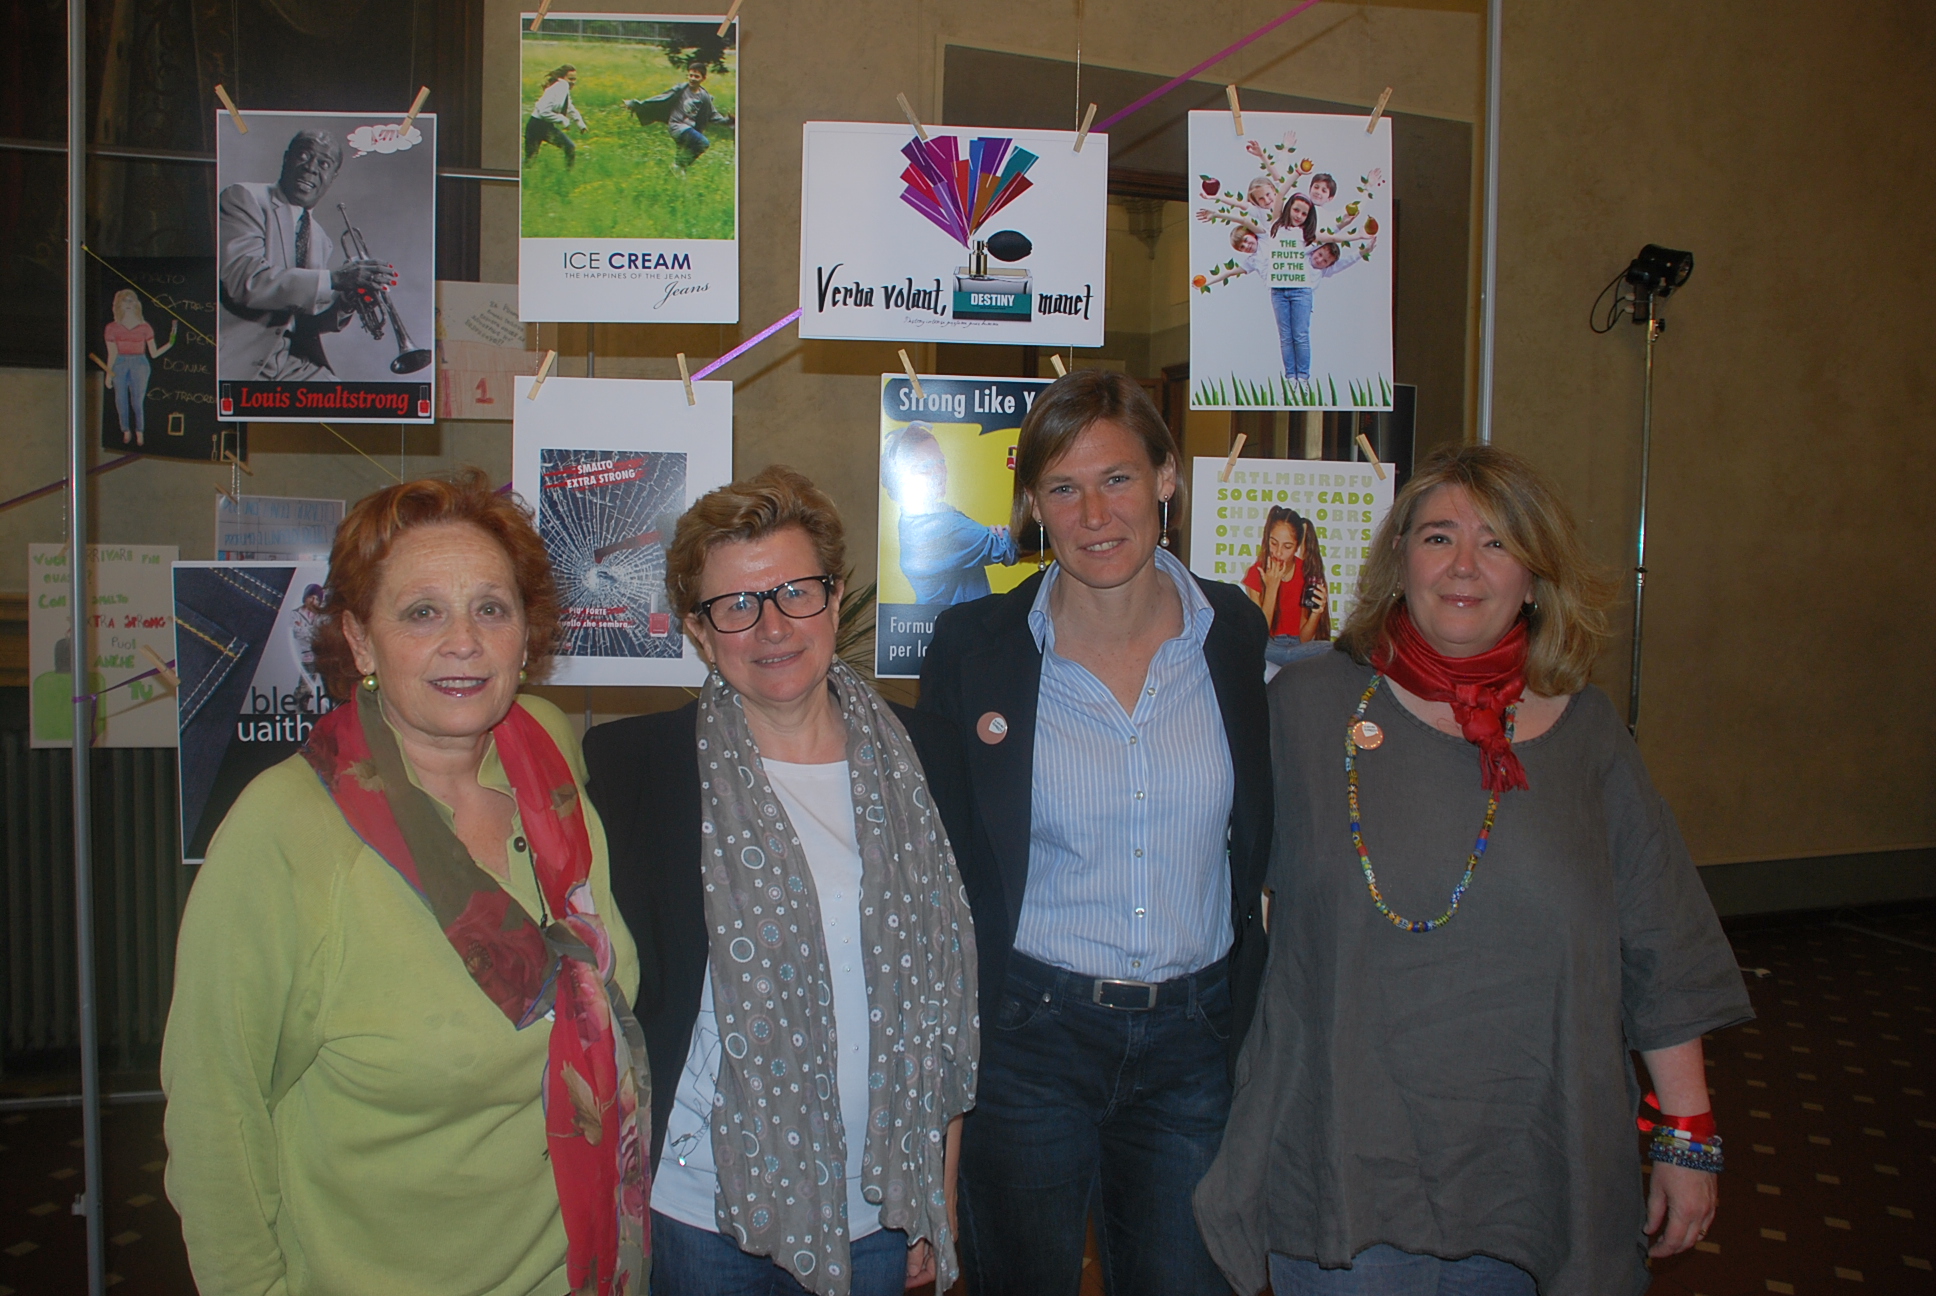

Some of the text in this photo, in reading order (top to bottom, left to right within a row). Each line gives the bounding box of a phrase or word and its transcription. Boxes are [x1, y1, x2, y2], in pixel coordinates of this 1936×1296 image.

[1280, 240, 1297, 248] THE
[563, 252, 692, 270] ICE CREAM
[1271, 251, 1305, 259] FRUITS
[1272, 262, 1285, 270] OF
[583, 272, 627, 280] HAPPINES
[1271, 274, 1306, 282] FUTURE
[653, 281, 711, 310] Jeans
[881, 277, 947, 317] volant,
[970, 293, 1015, 307] DESTINY
[475, 377, 495, 405] 1
[240, 385, 409, 415] Louis Smaltstrong
[899, 387, 966, 418] Strong
[974, 386, 1016, 414] Like
[577, 460, 613, 475] SMALTO
[566, 469, 636, 489] EXTRA STRONG
[585, 607, 607, 616] FORTE
[583, 619, 597, 628] che
[890, 615, 938, 634] Formu
[889, 645, 912, 661] per
[252, 685, 333, 714] blech
